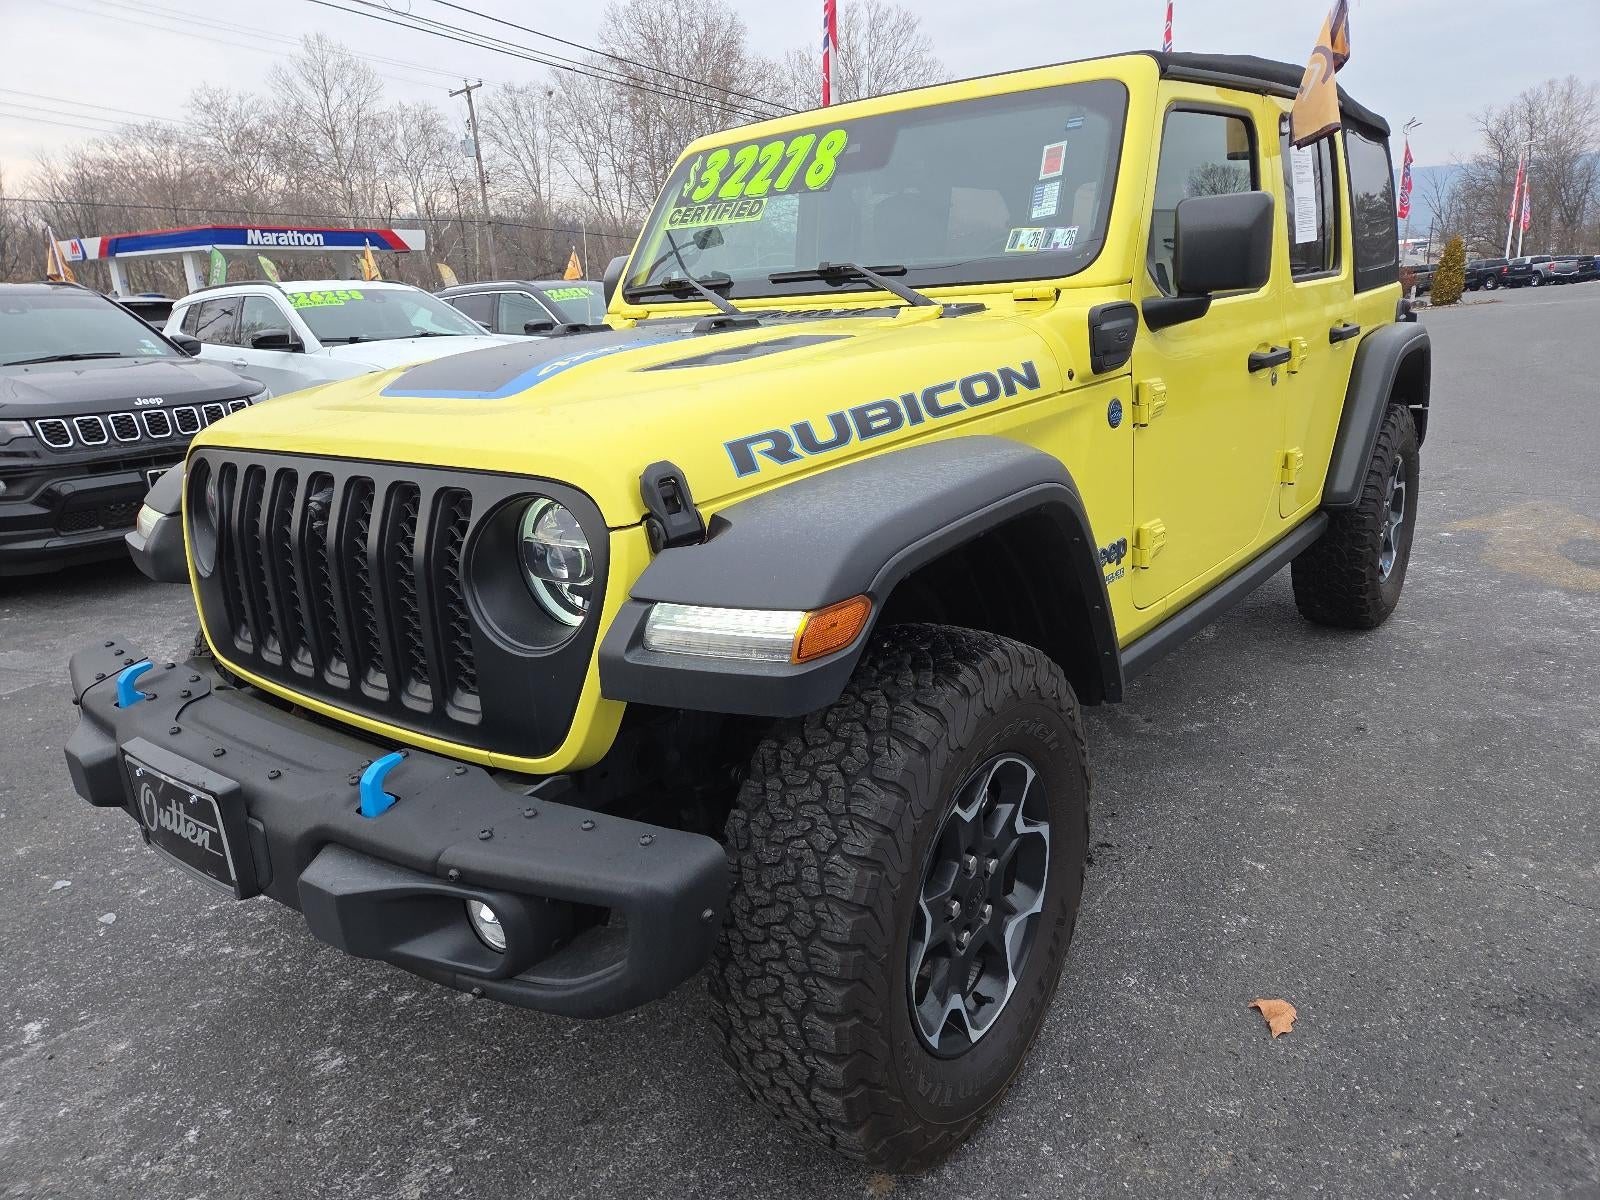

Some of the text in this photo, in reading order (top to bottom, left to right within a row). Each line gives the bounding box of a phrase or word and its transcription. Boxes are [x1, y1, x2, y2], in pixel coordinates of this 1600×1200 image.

[668, 200, 764, 226] CERTIFIED
[247, 229, 324, 246] Marathon
[134, 397, 164, 406] Jeep
[722, 359, 1041, 479] RUBICON
[1096, 537, 1128, 567] eep
